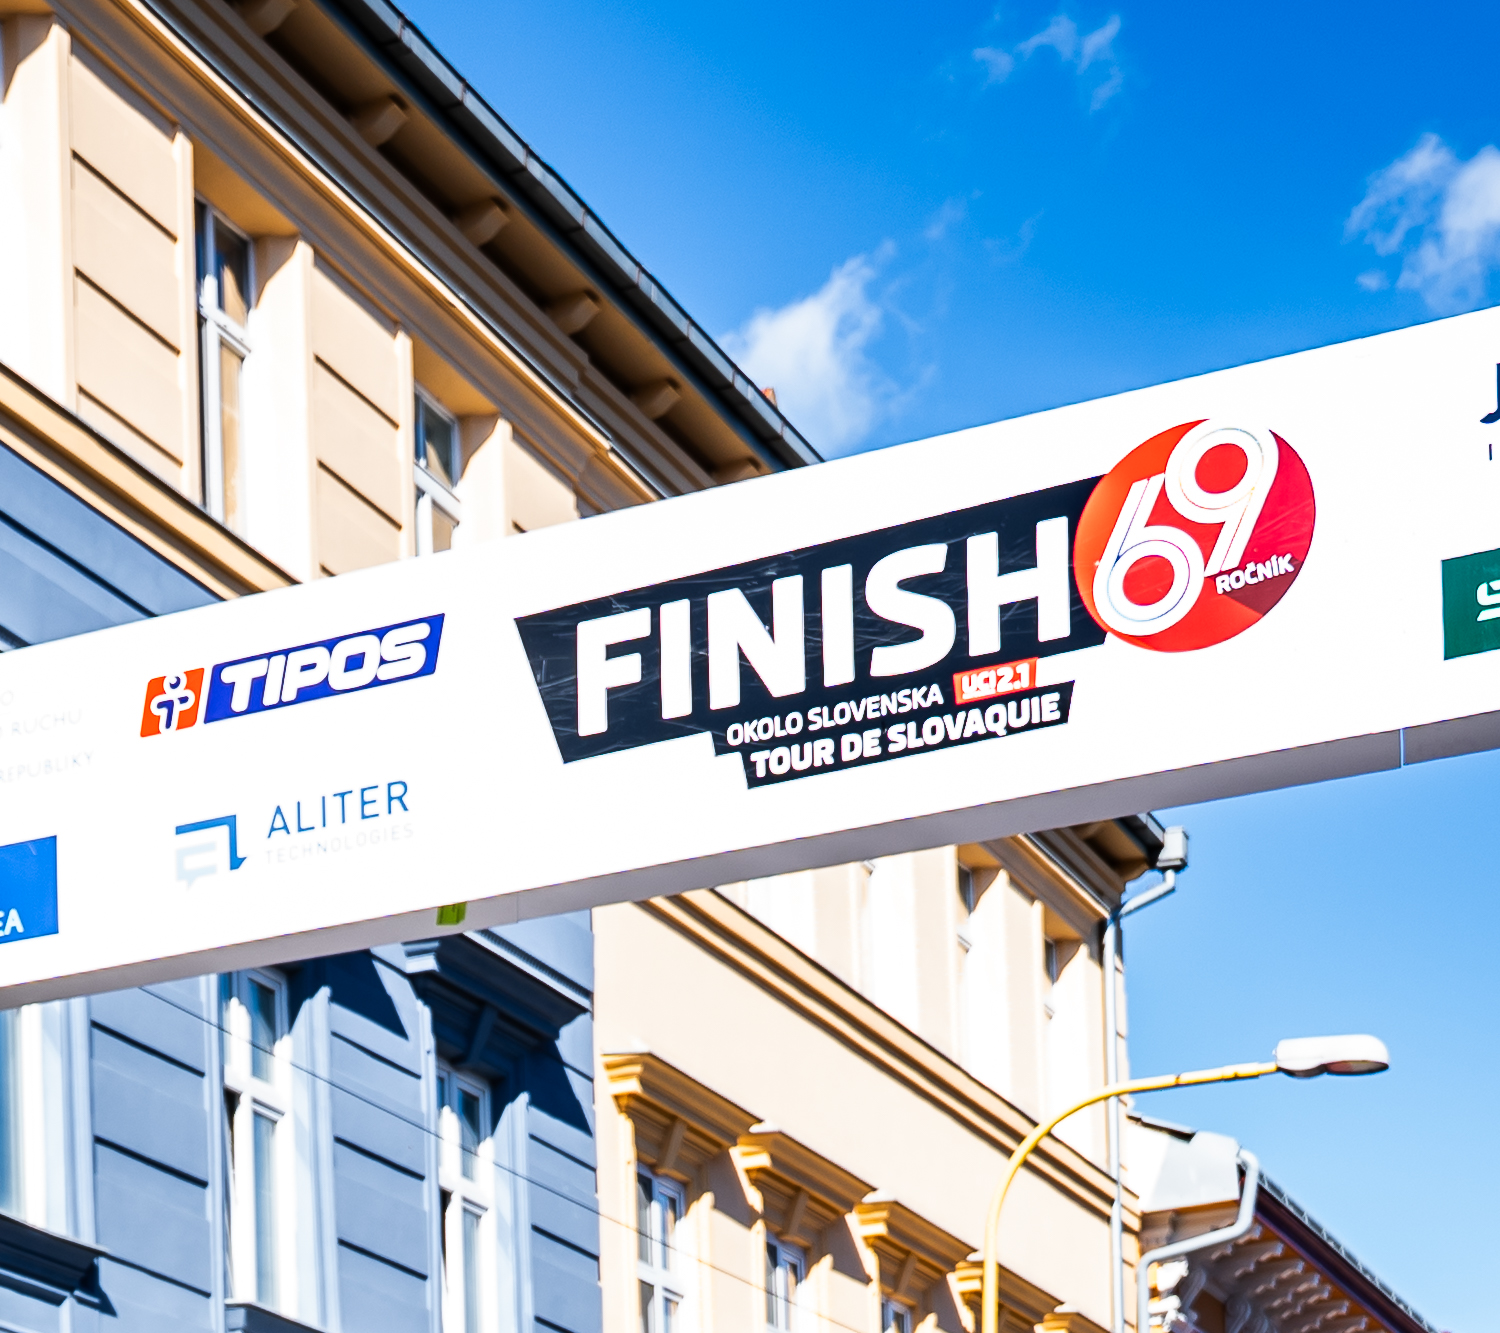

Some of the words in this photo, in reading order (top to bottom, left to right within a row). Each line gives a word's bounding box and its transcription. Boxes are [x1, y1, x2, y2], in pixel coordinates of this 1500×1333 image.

[574, 516, 1072, 739] FINISH
[1091, 423, 1280, 638] 69
[1214, 551, 1297, 596] ROČNÍK
[219, 619, 432, 714] TIPOS
[726, 711, 804, 747] OKOLO
[807, 683, 945, 732] SLOVENSKA
[749, 737, 835, 779] TOUR
[840, 729, 882, 763] DE
[886, 691, 1062, 753] SLOVAQUIE
[266, 780, 411, 841] ALITER
